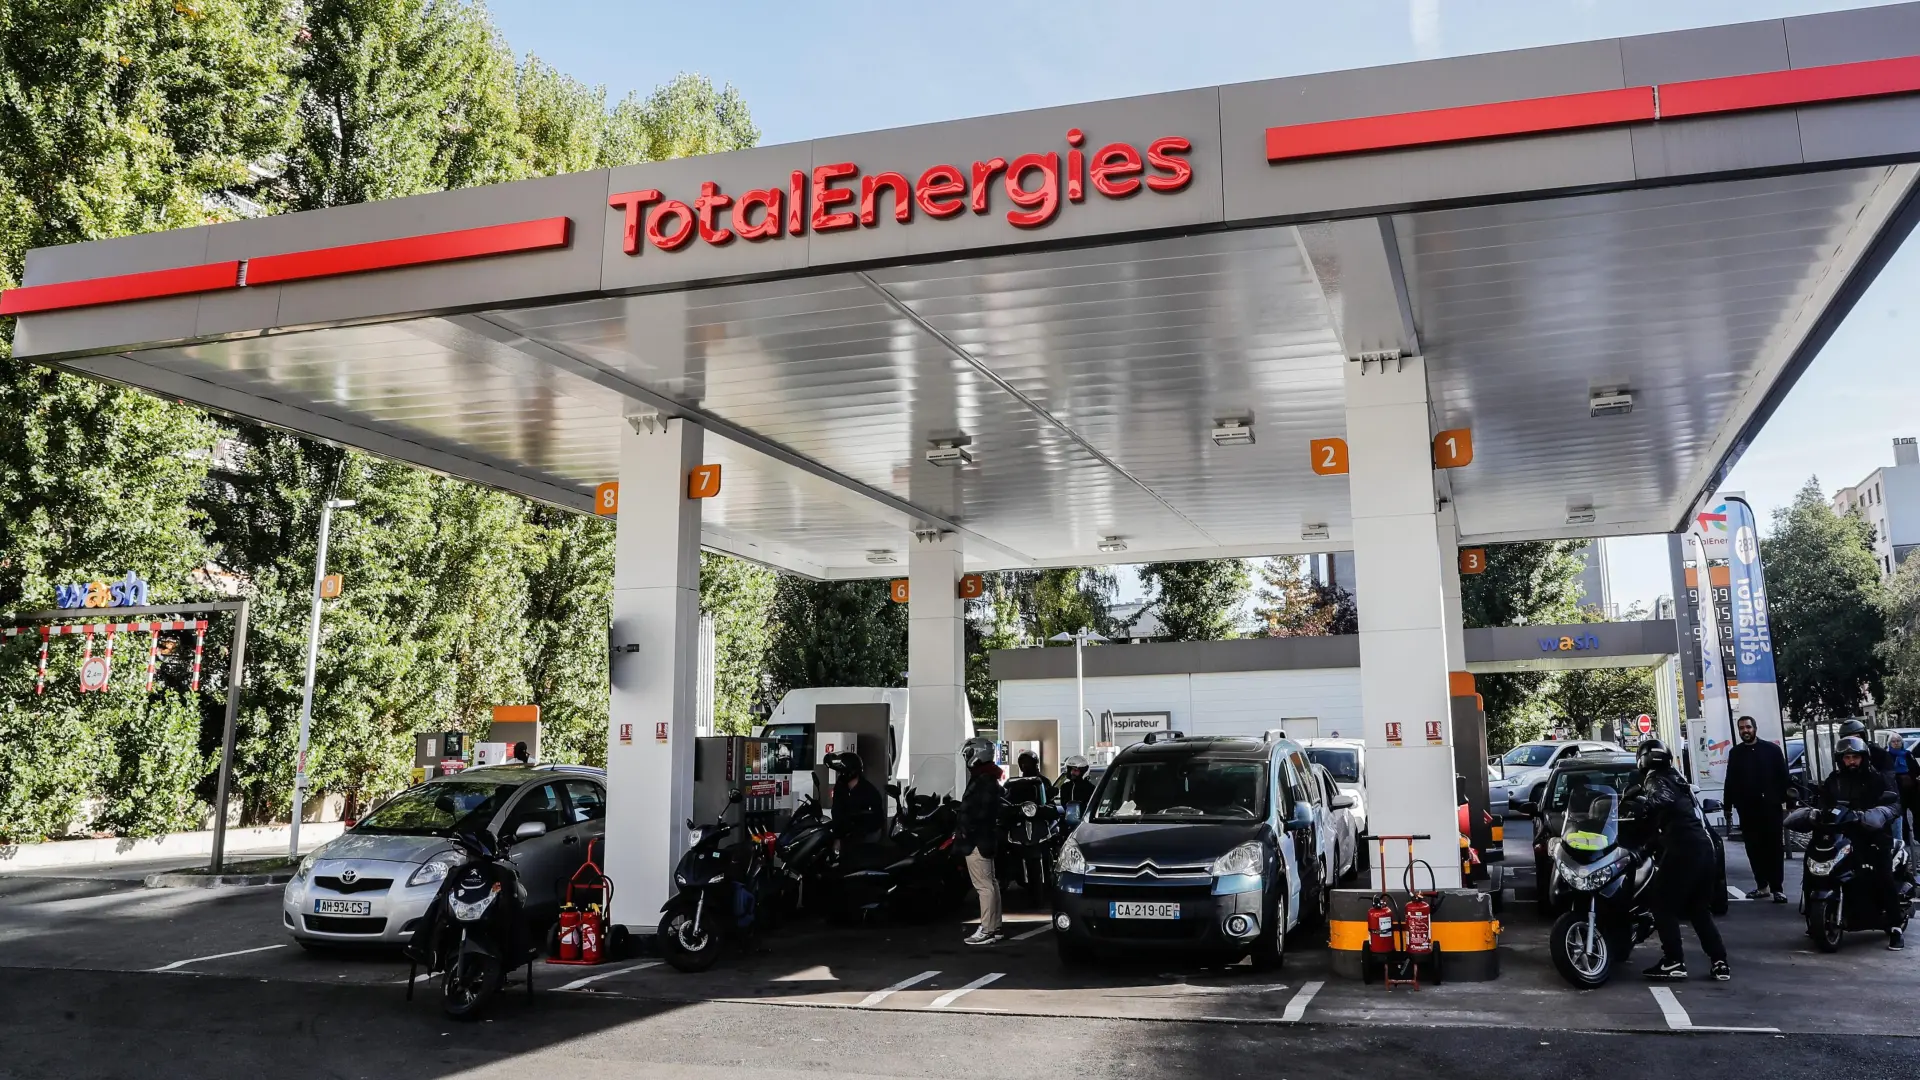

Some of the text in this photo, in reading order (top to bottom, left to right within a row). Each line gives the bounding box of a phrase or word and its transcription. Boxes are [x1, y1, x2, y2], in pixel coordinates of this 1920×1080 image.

[609, 128, 1192, 255] TotalEnergies
[1321, 446, 1337, 468] 2
[1445, 437, 1457, 459] 1
[700, 471, 711, 491] 7
[603, 488, 615, 508] 8
[1468, 554, 1478, 569] 3
[56, 570, 147, 608] wash
[897, 584, 906, 598] 6
[966, 579, 975, 594] 5
[1537, 631, 1599, 651] wash
[1113, 718, 1159, 730] aspirateur
[321, 901, 363, 914] AH-934-CS
[1117, 904, 1172, 917] CA-219-QE
